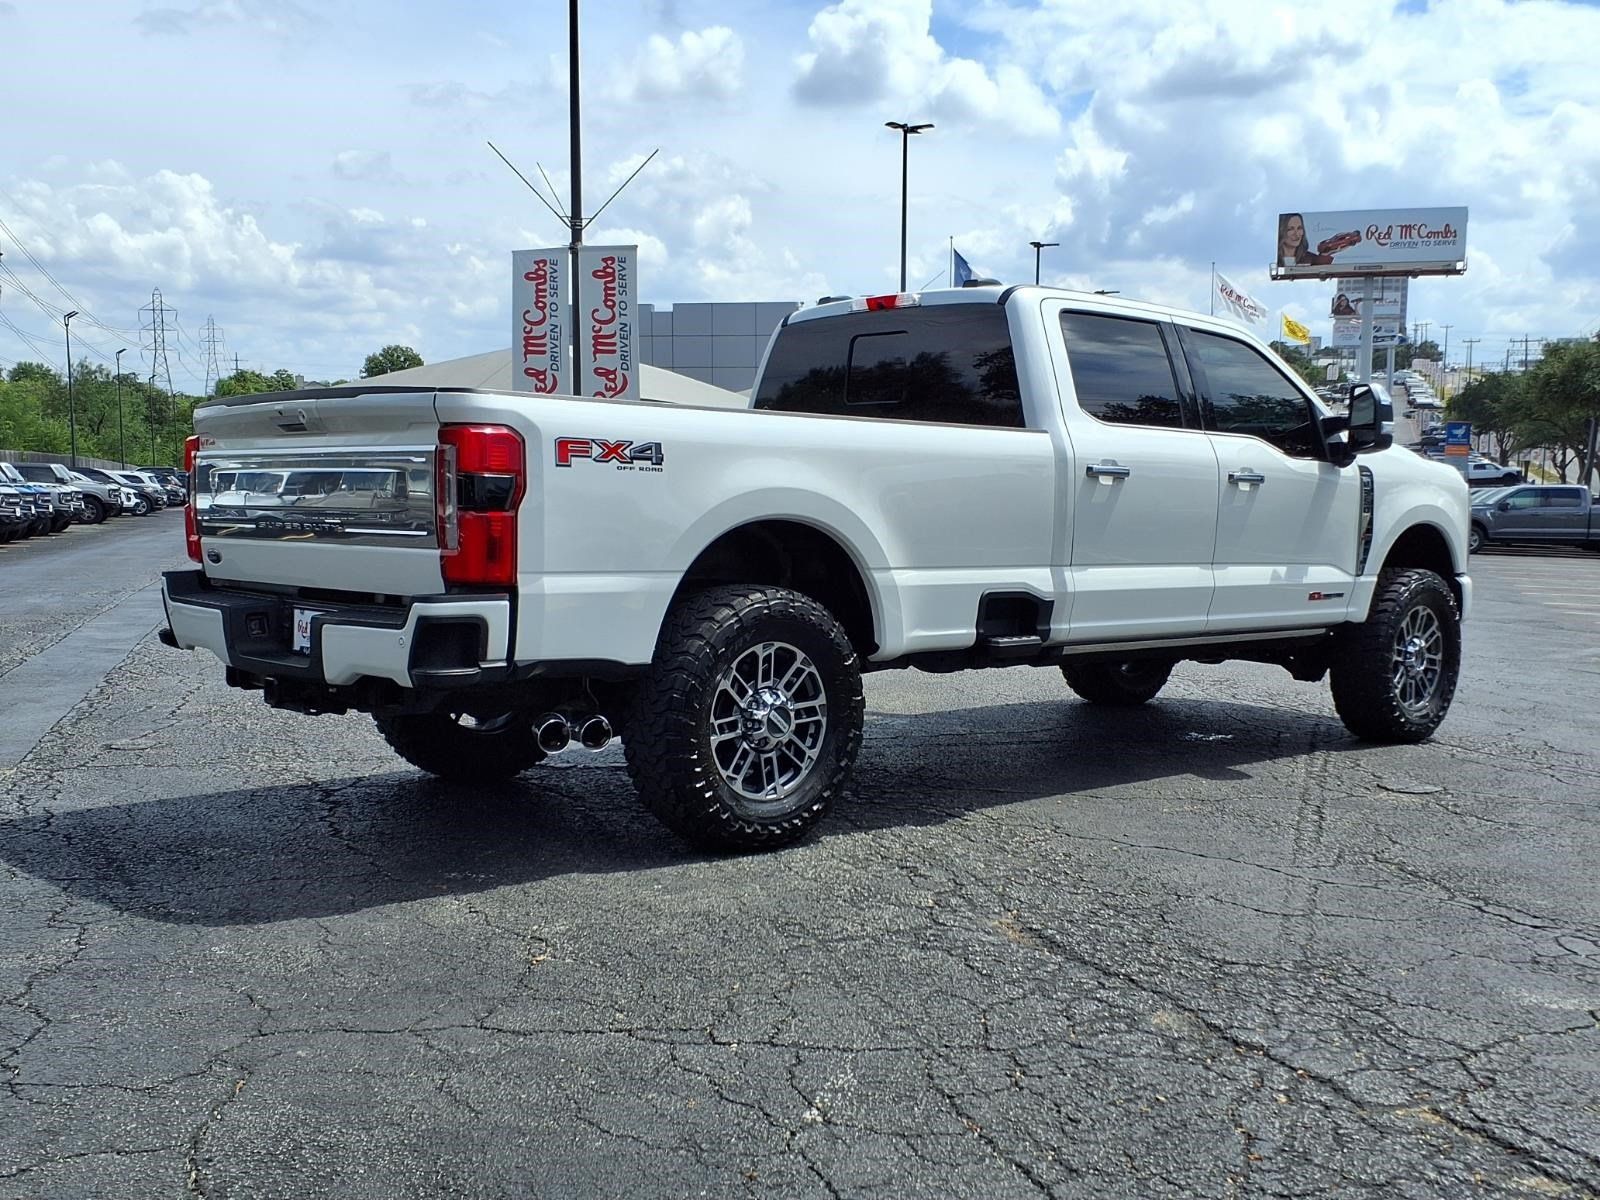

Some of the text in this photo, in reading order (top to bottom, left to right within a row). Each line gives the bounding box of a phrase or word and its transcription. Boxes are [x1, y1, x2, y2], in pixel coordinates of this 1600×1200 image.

[1365, 223, 1457, 247] Red McCombs
[1389, 240, 1419, 249] DRIVEN
[1433, 239, 1456, 247] SERVE
[522, 258, 558, 395] ed McCombs
[549, 258, 560, 372] DRIVEN TO SERVE
[591, 255, 617, 362] McCombs
[617, 256, 630, 371] DRIVEN TO SERVE
[554, 436, 664, 467] FX4
